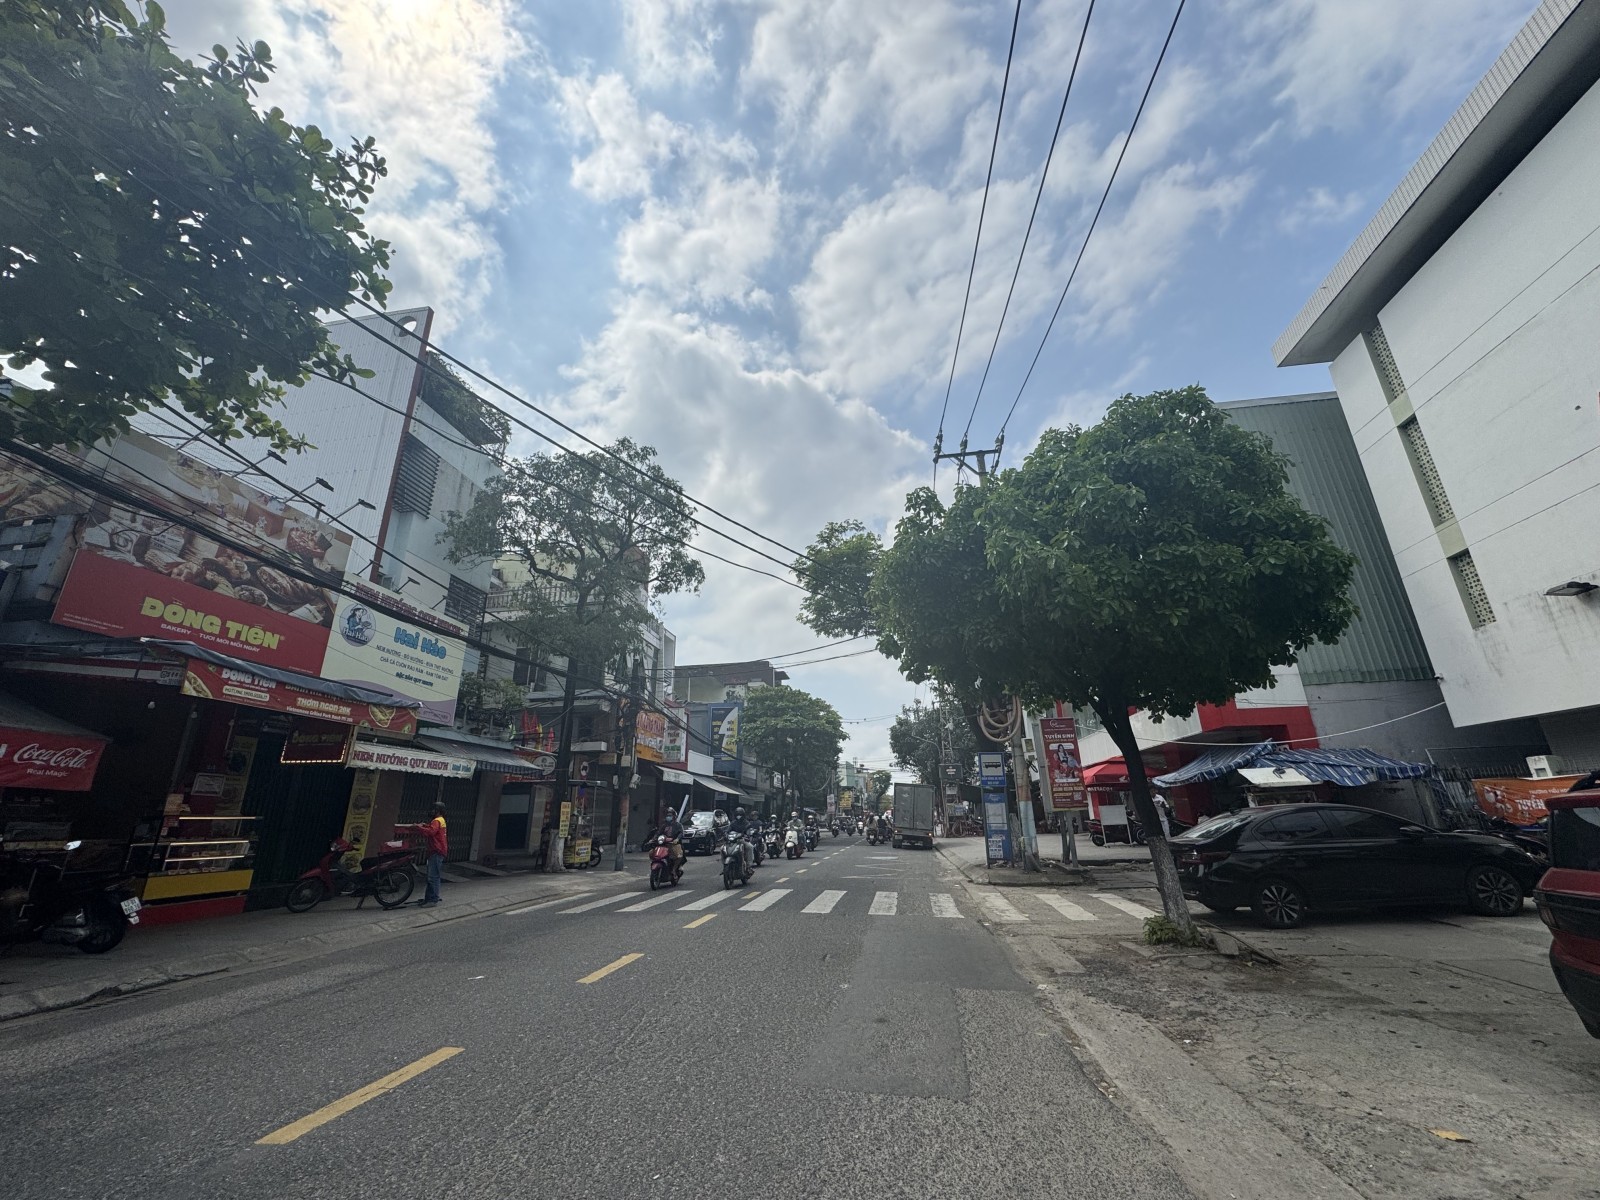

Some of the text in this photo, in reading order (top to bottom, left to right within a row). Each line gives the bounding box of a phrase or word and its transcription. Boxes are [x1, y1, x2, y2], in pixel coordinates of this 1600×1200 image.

[161, 623, 192, 636] BAKERY
[393, 626, 447, 660] Hai Hảo
[13, 743, 96, 768] Coca-Cola
[353, 750, 375, 761] NEM
[375, 752, 409, 766] NƯỚNG
[409, 757, 427, 769] QUY
[427, 760, 449, 771] NHƠN
[27, 768, 70, 778] Real Magic
[1516, 794, 1547, 811] TUYỂN
